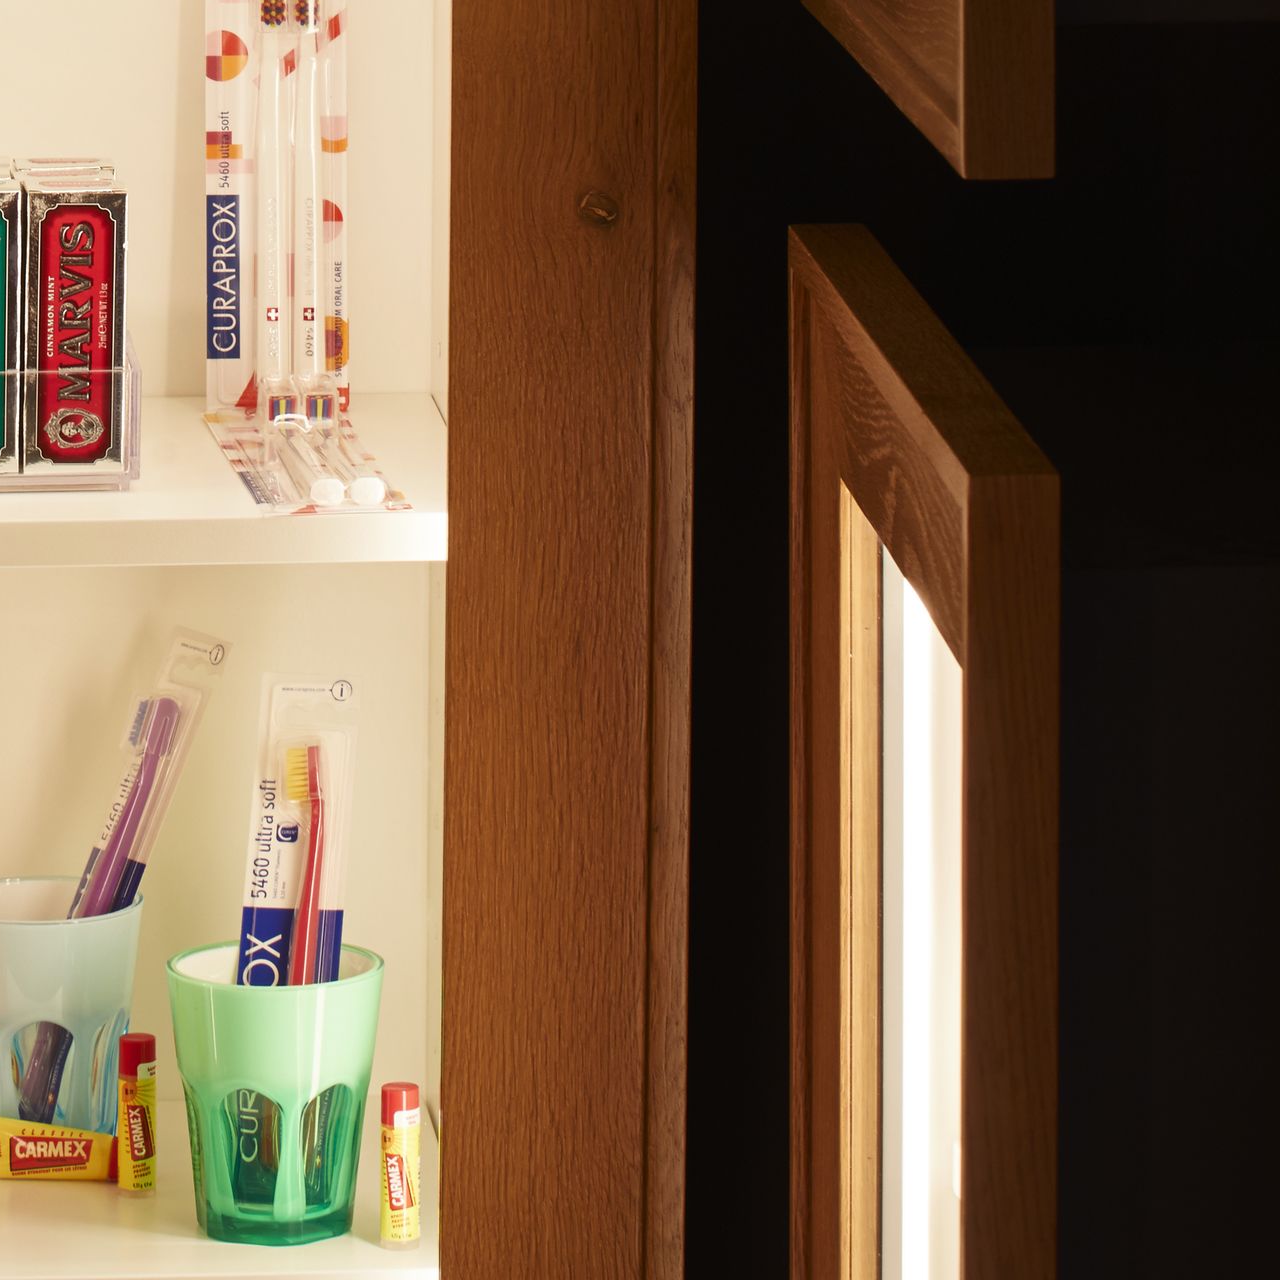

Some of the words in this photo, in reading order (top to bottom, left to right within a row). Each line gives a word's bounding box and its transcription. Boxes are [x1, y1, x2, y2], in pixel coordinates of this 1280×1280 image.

[218, 111, 230, 131] soft
[218, 161, 230, 188] 5460
[47, 275, 55, 301] MINT
[212, 202, 237, 352] CURAPROX
[334, 261, 343, 283] CARE
[57, 221, 95, 403] MARVIS
[334, 286, 343, 307] ORAL
[46, 305, 54, 357] CINNAMON
[259, 780, 276, 811] soft
[255, 817, 273, 853] ultra
[251, 857, 270, 899] 5460
[129, 1107, 146, 1156] CARMEX
[15, 1140, 87, 1159] CARMEX
[386, 1156, 404, 1207] CARMEX
